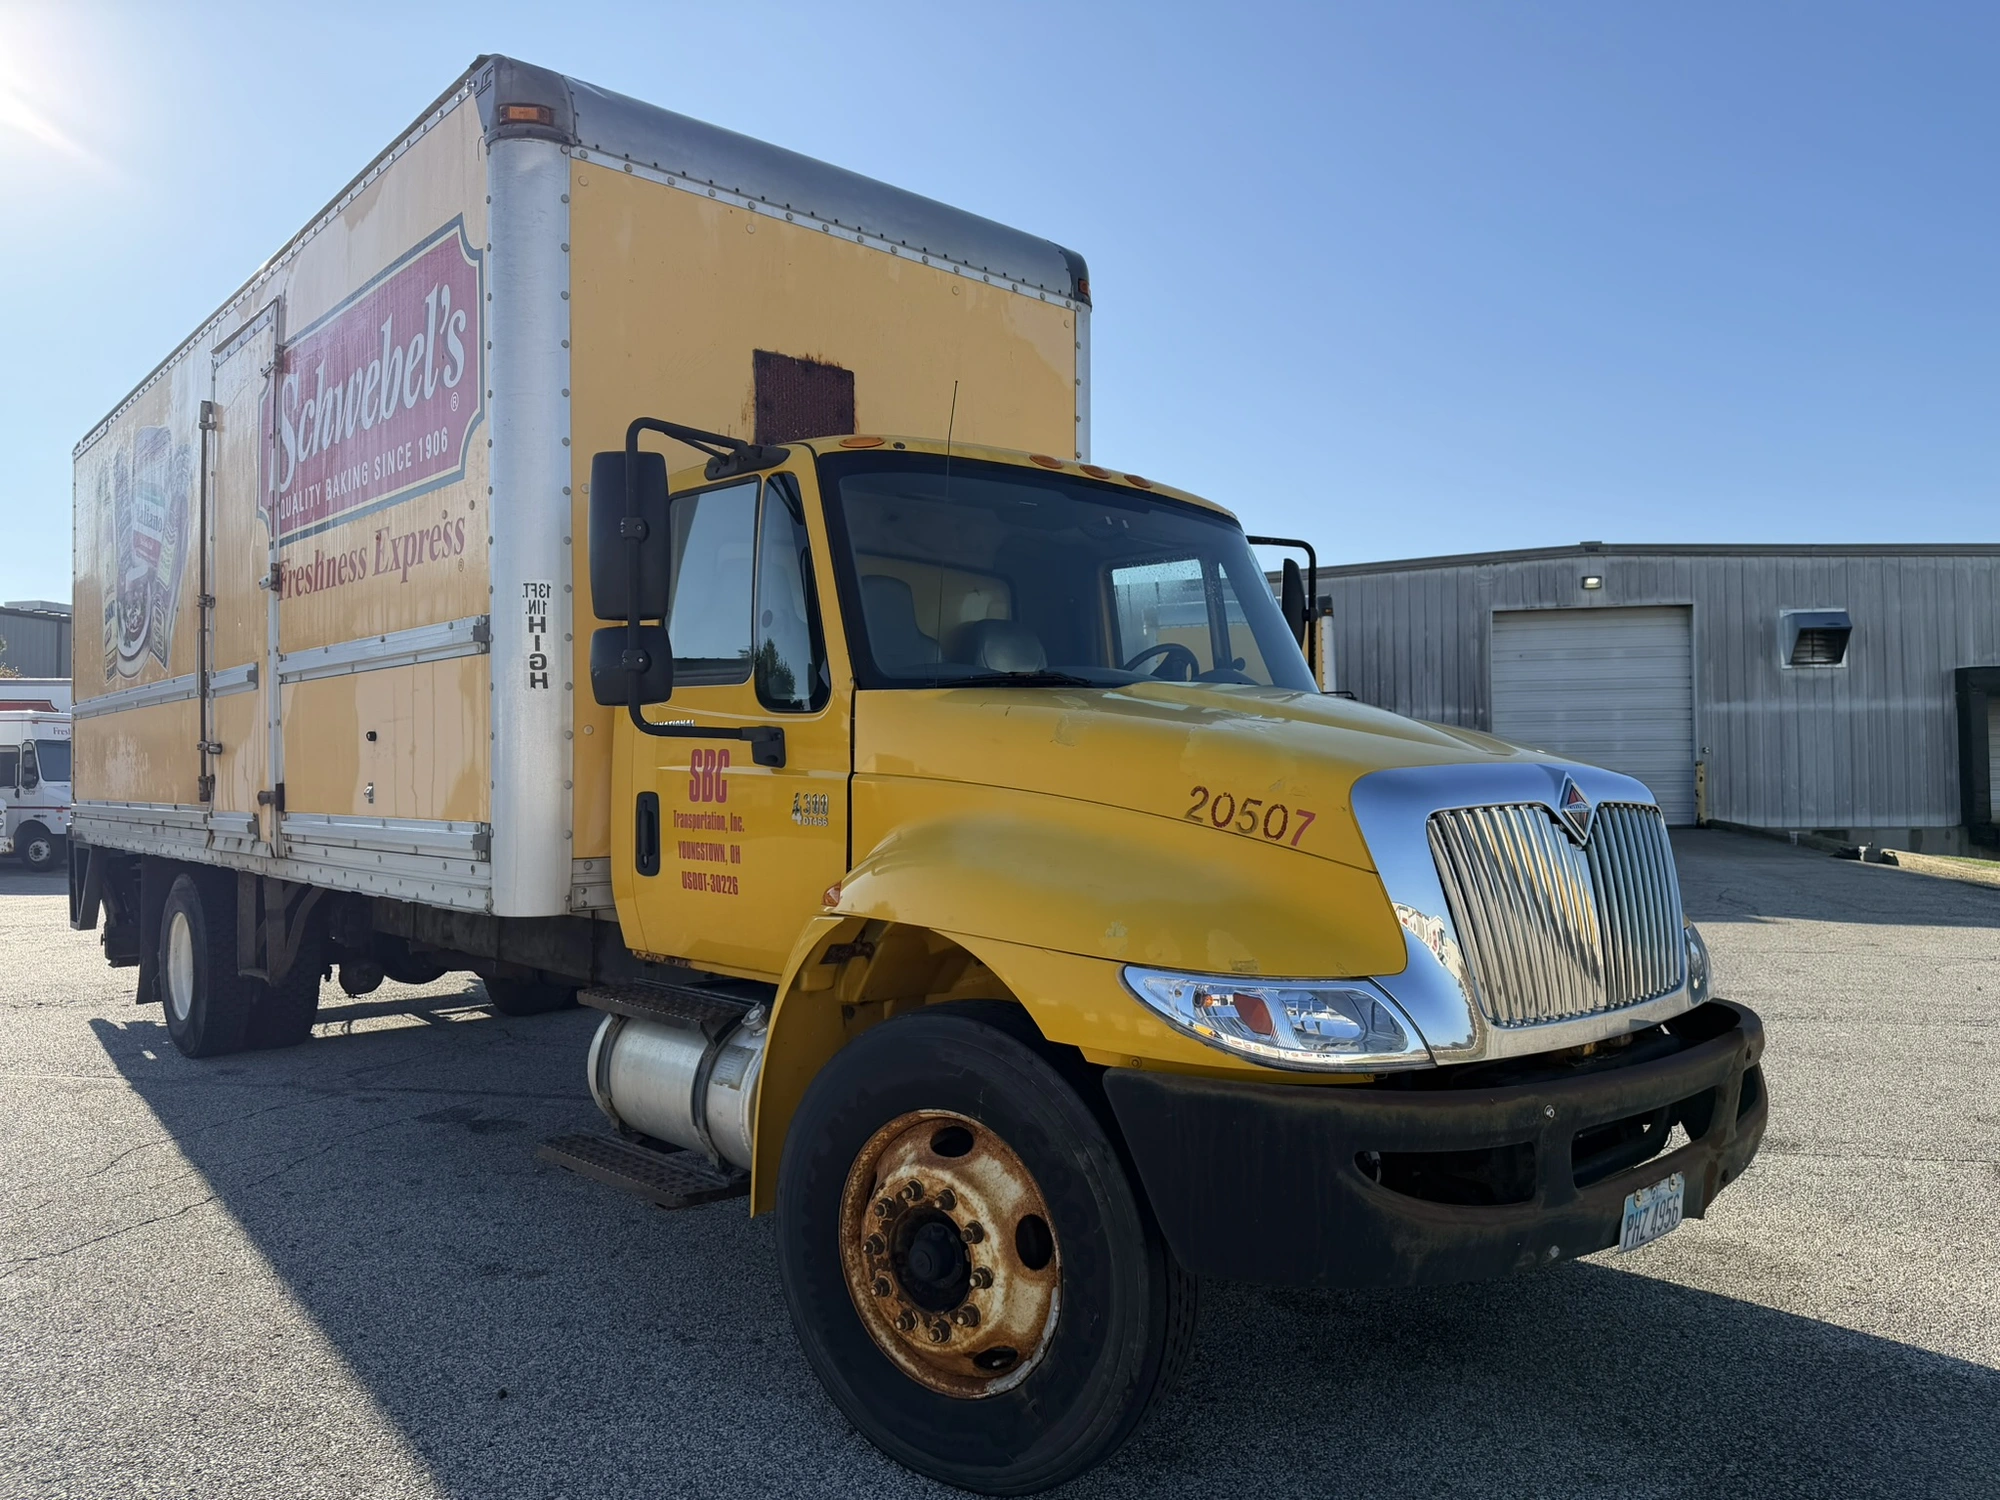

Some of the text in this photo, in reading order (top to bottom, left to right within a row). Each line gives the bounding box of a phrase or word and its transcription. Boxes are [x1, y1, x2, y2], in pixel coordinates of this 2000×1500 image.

[269, 282, 466, 493] Schwebel's
[280, 427, 448, 519] QUALITY BAKING SINCE 1906
[278, 516, 466, 601] Freshness Express
[689, 749, 730, 803] SBC
[673, 810, 745, 834] Transportation, Inc.
[1184, 785, 1316, 847] 20507
[678, 841, 741, 865] YOUNGSTOWN, OH
[681, 871, 738, 895] USDOT-30226
[1624, 1193, 1680, 1248] PHZ 4956
